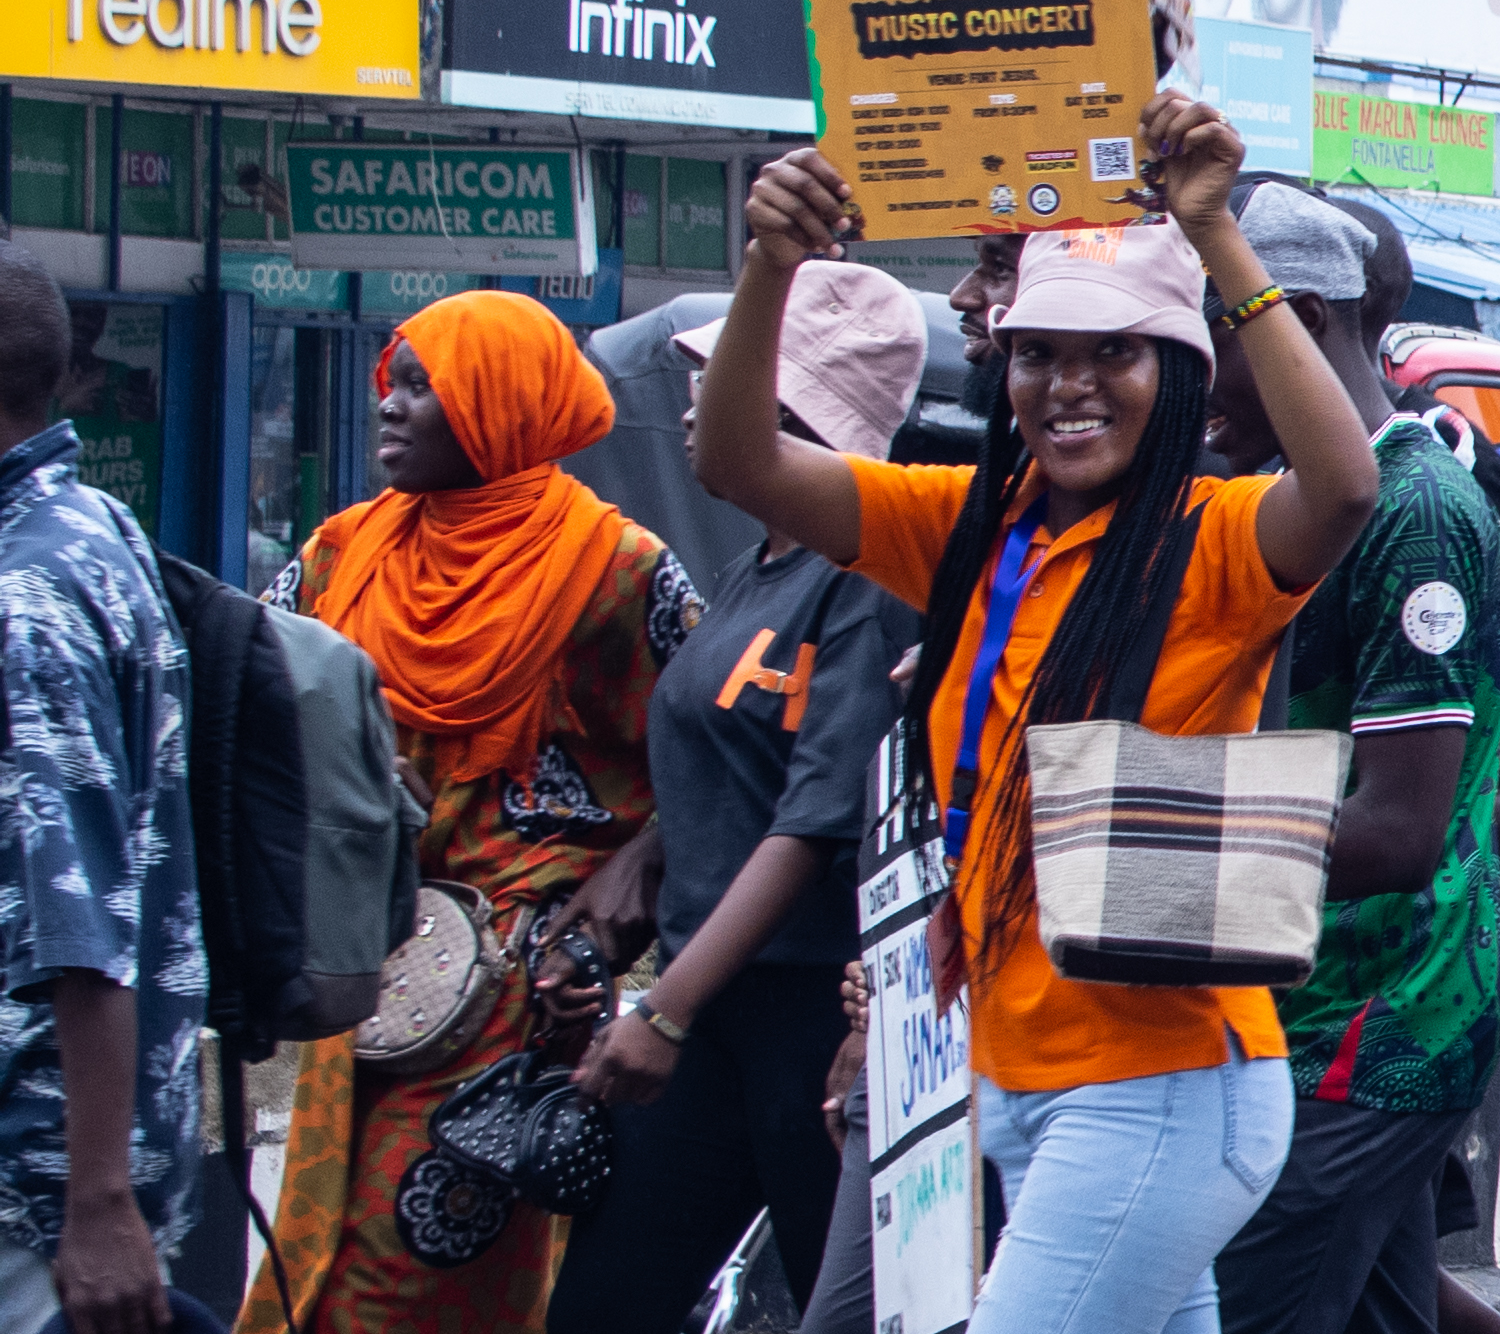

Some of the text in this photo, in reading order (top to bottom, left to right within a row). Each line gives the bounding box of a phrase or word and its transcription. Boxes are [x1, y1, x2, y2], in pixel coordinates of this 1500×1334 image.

[866, 4, 1090, 42] MUSIC CONCERT
[1314, 93, 1487, 149] BLUE MARLIN LOUNGE
[1352, 138, 1435, 174] FONTANELLA
[310, 157, 554, 200] SAFARICOM
[313, 204, 556, 236] CUSTOMER CARE
[391, 272, 447, 304] oppo
